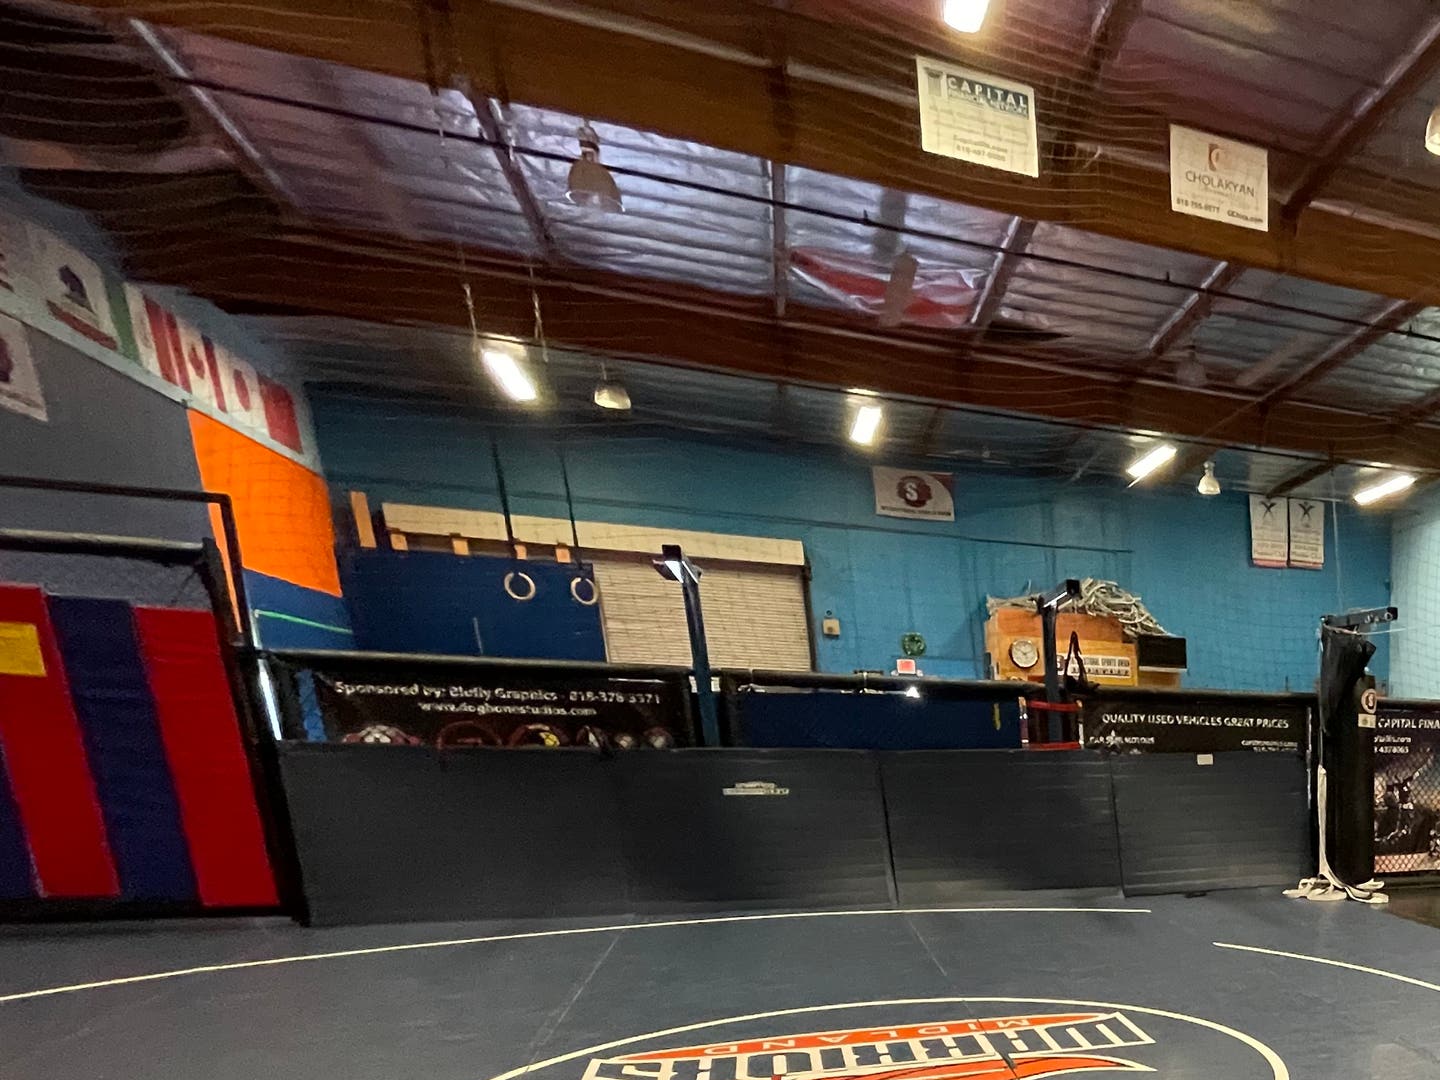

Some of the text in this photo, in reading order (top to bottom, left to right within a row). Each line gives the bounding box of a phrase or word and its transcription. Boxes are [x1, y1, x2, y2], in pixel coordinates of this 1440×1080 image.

[947, 78, 1027, 108] CAPITAL
[1185, 170, 1255, 198] CHOLAKYAN
[335, 681, 419, 696] Sponsored
[494, 687, 558, 702] Graphics
[1102, 714, 1289, 729] QUALITY USED VEHICLES GREAT PRICES
[1378, 718, 1416, 729] CAPITAL
[703, 1018, 1031, 1055] MIDLAND
